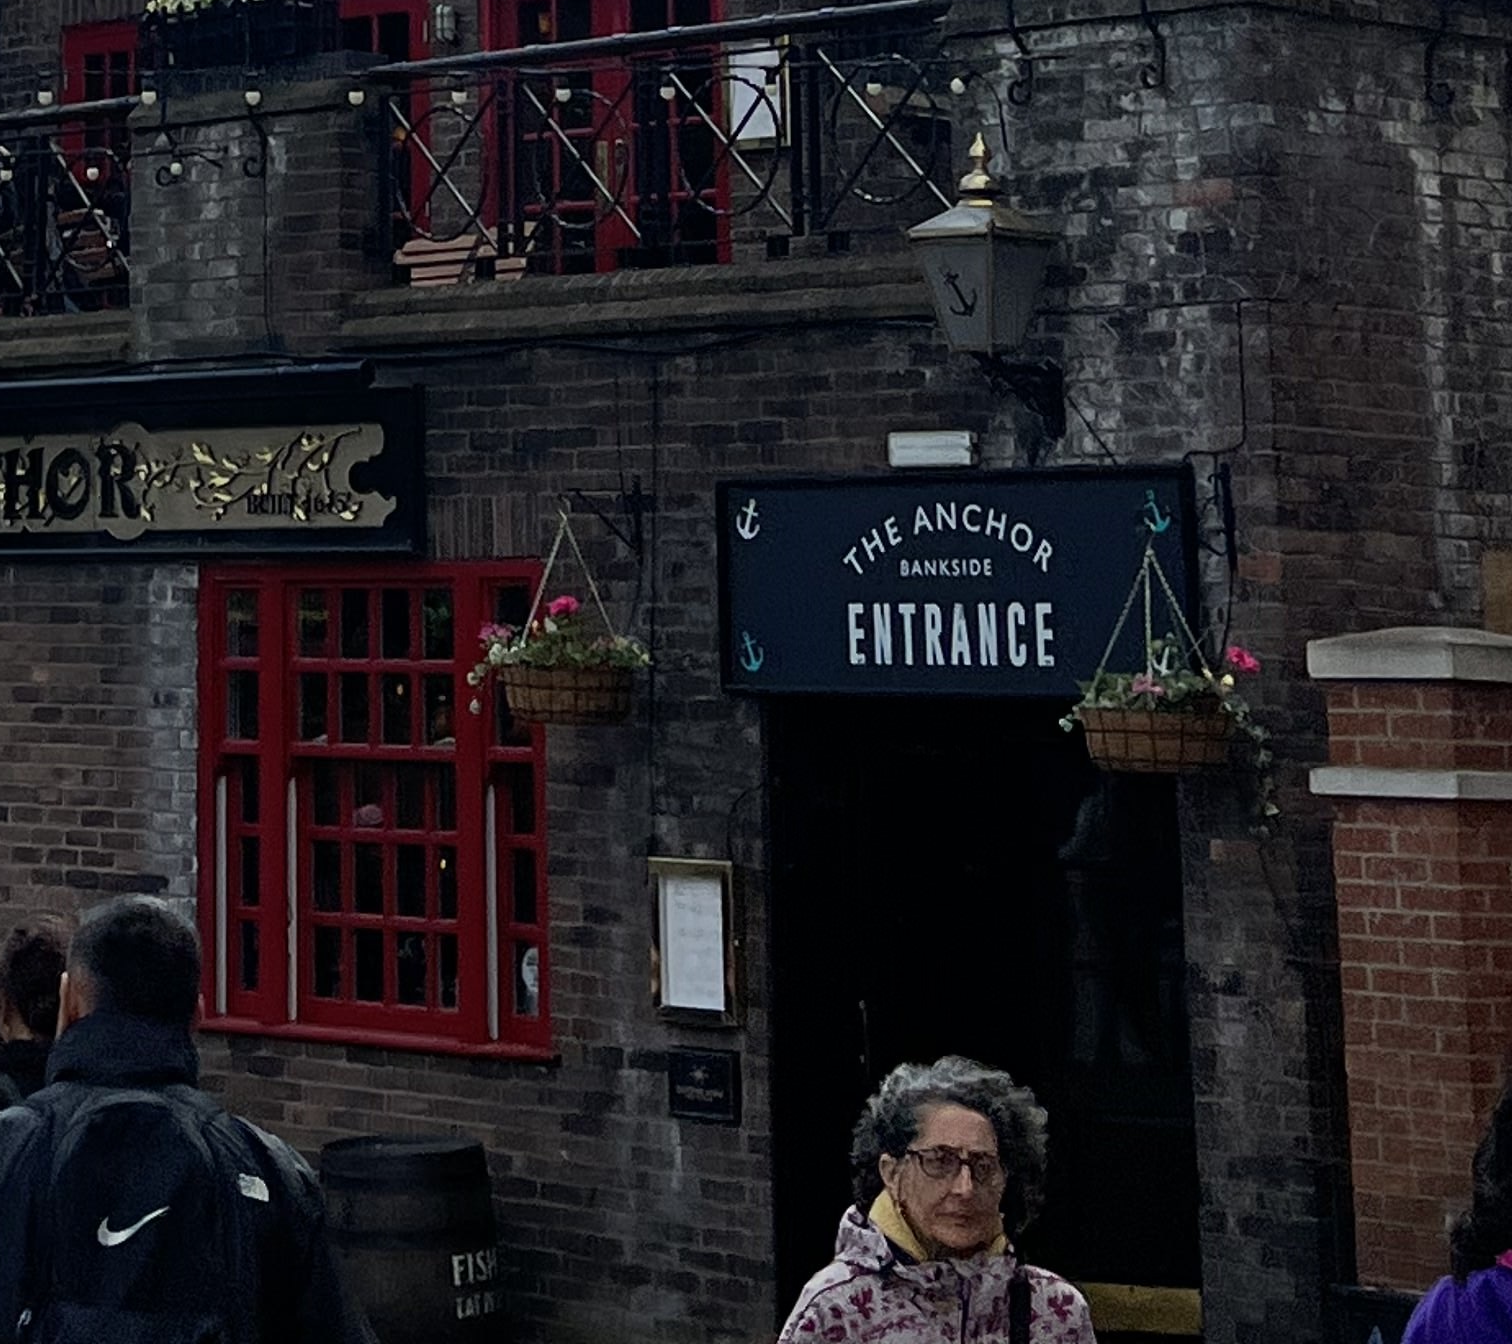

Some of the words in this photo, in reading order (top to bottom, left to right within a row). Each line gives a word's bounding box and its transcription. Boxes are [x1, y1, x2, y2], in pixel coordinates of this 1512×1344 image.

[842, 516, 903, 575] THE
[913, 502, 1053, 572] ANCHOR
[899, 558, 993, 577] BANKSIDE
[847, 601, 1055, 667] ENTRANCE
[451, 1248, 497, 1286] FISH
